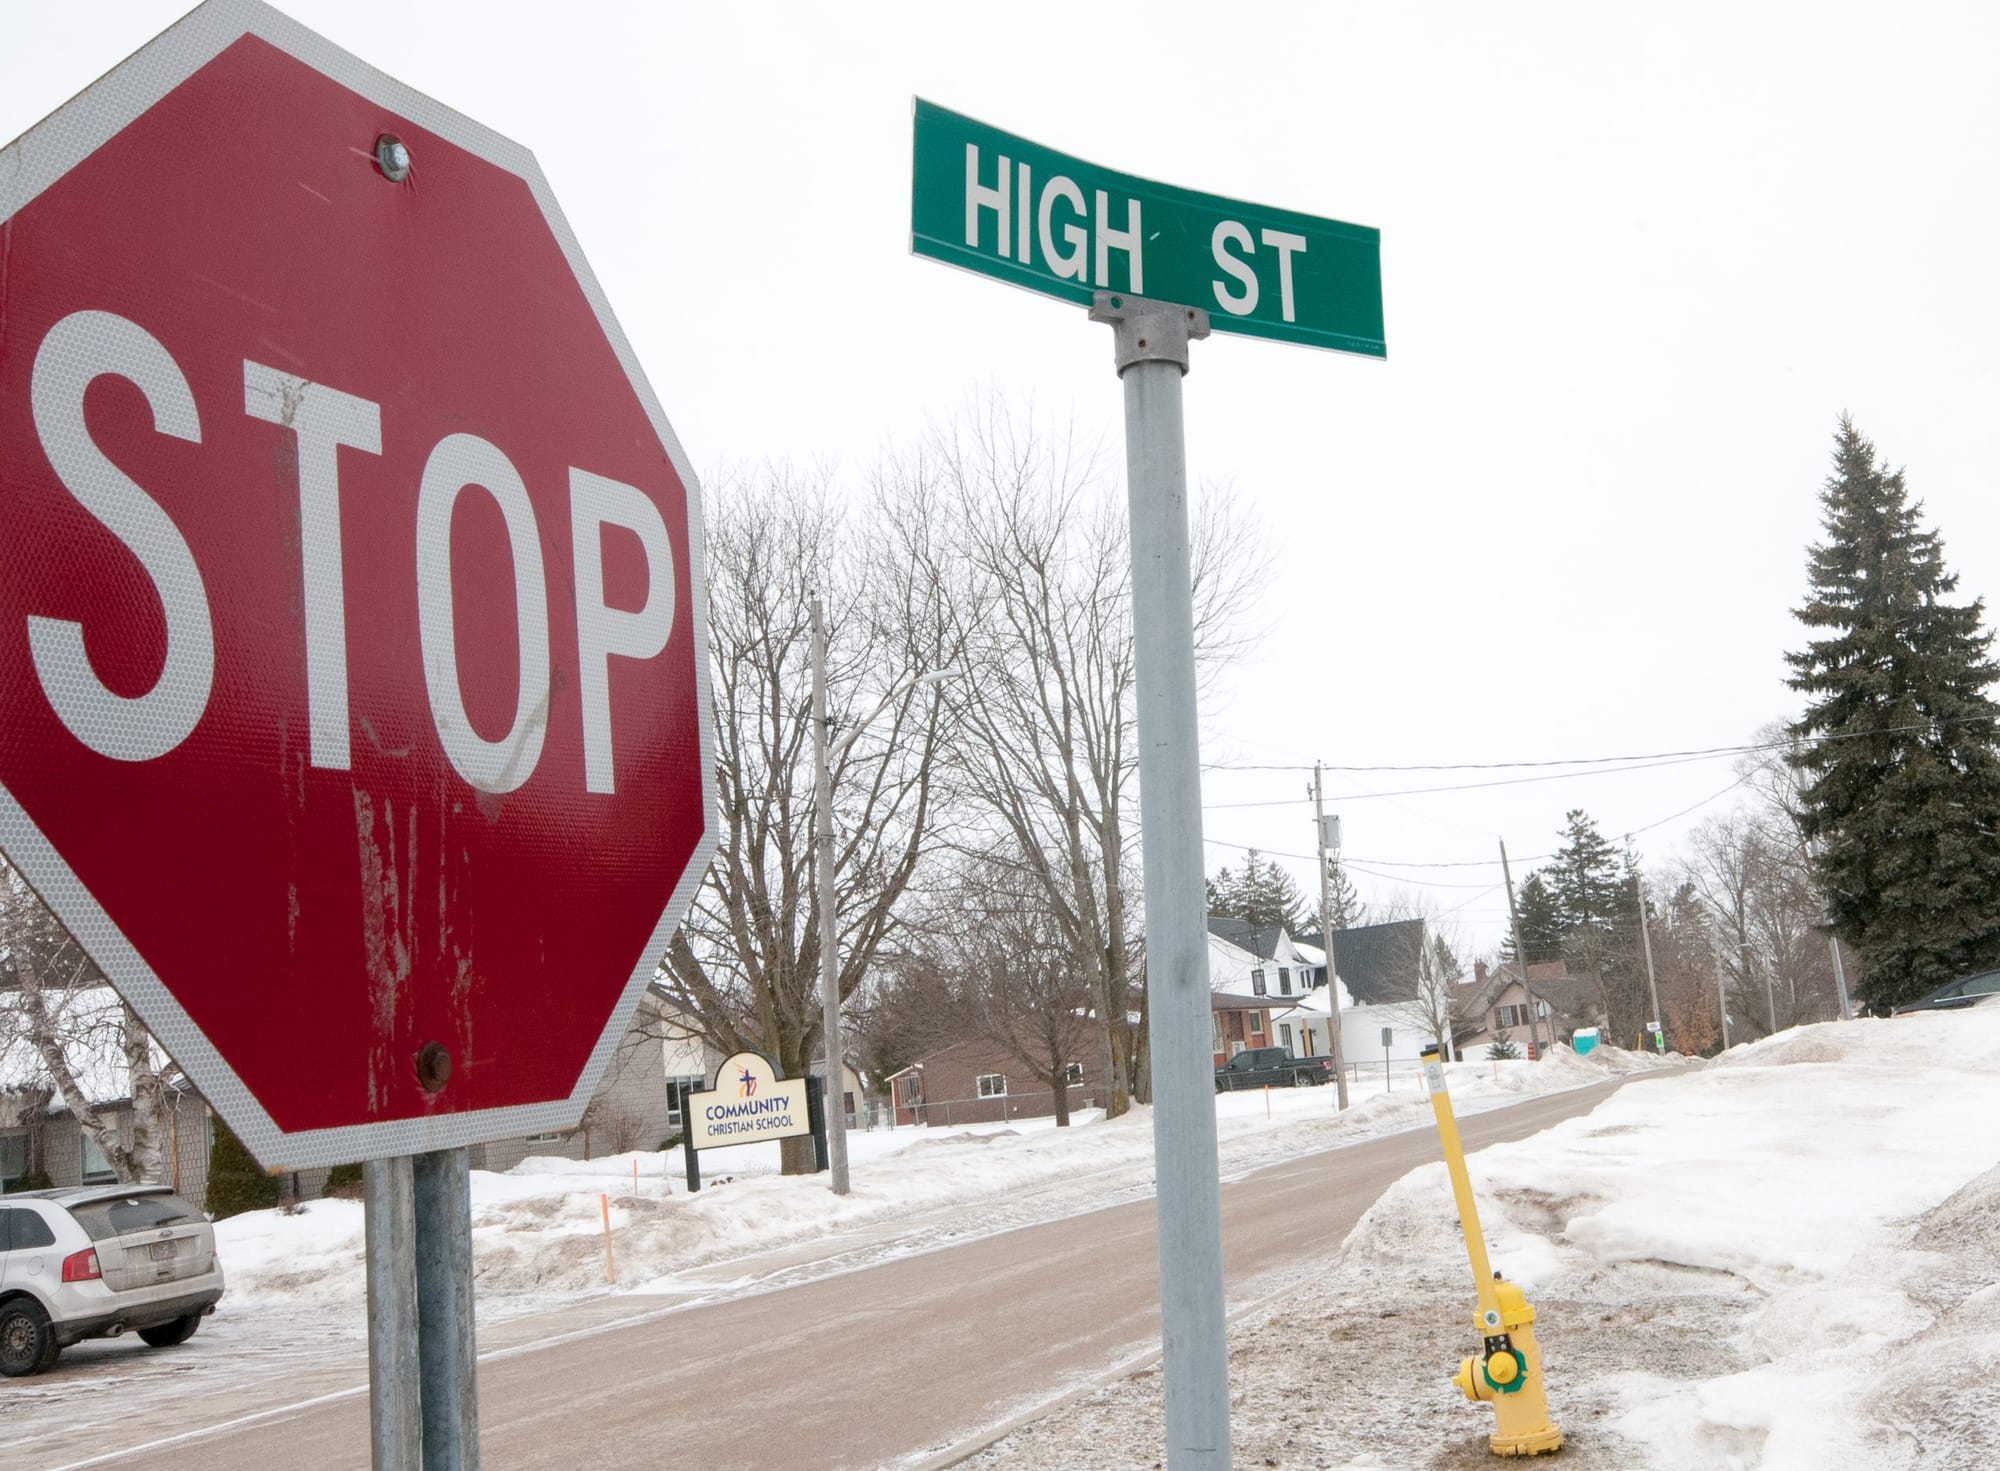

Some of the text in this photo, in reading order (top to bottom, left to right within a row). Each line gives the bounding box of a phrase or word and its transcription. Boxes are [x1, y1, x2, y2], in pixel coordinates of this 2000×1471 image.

[965, 143, 1307, 323] HIGH ST
[28, 309, 676, 795] STOP
[706, 1096, 789, 1121] COMMUNITY
[707, 1115, 793, 1136] CHRISTIAN SCHOOL
